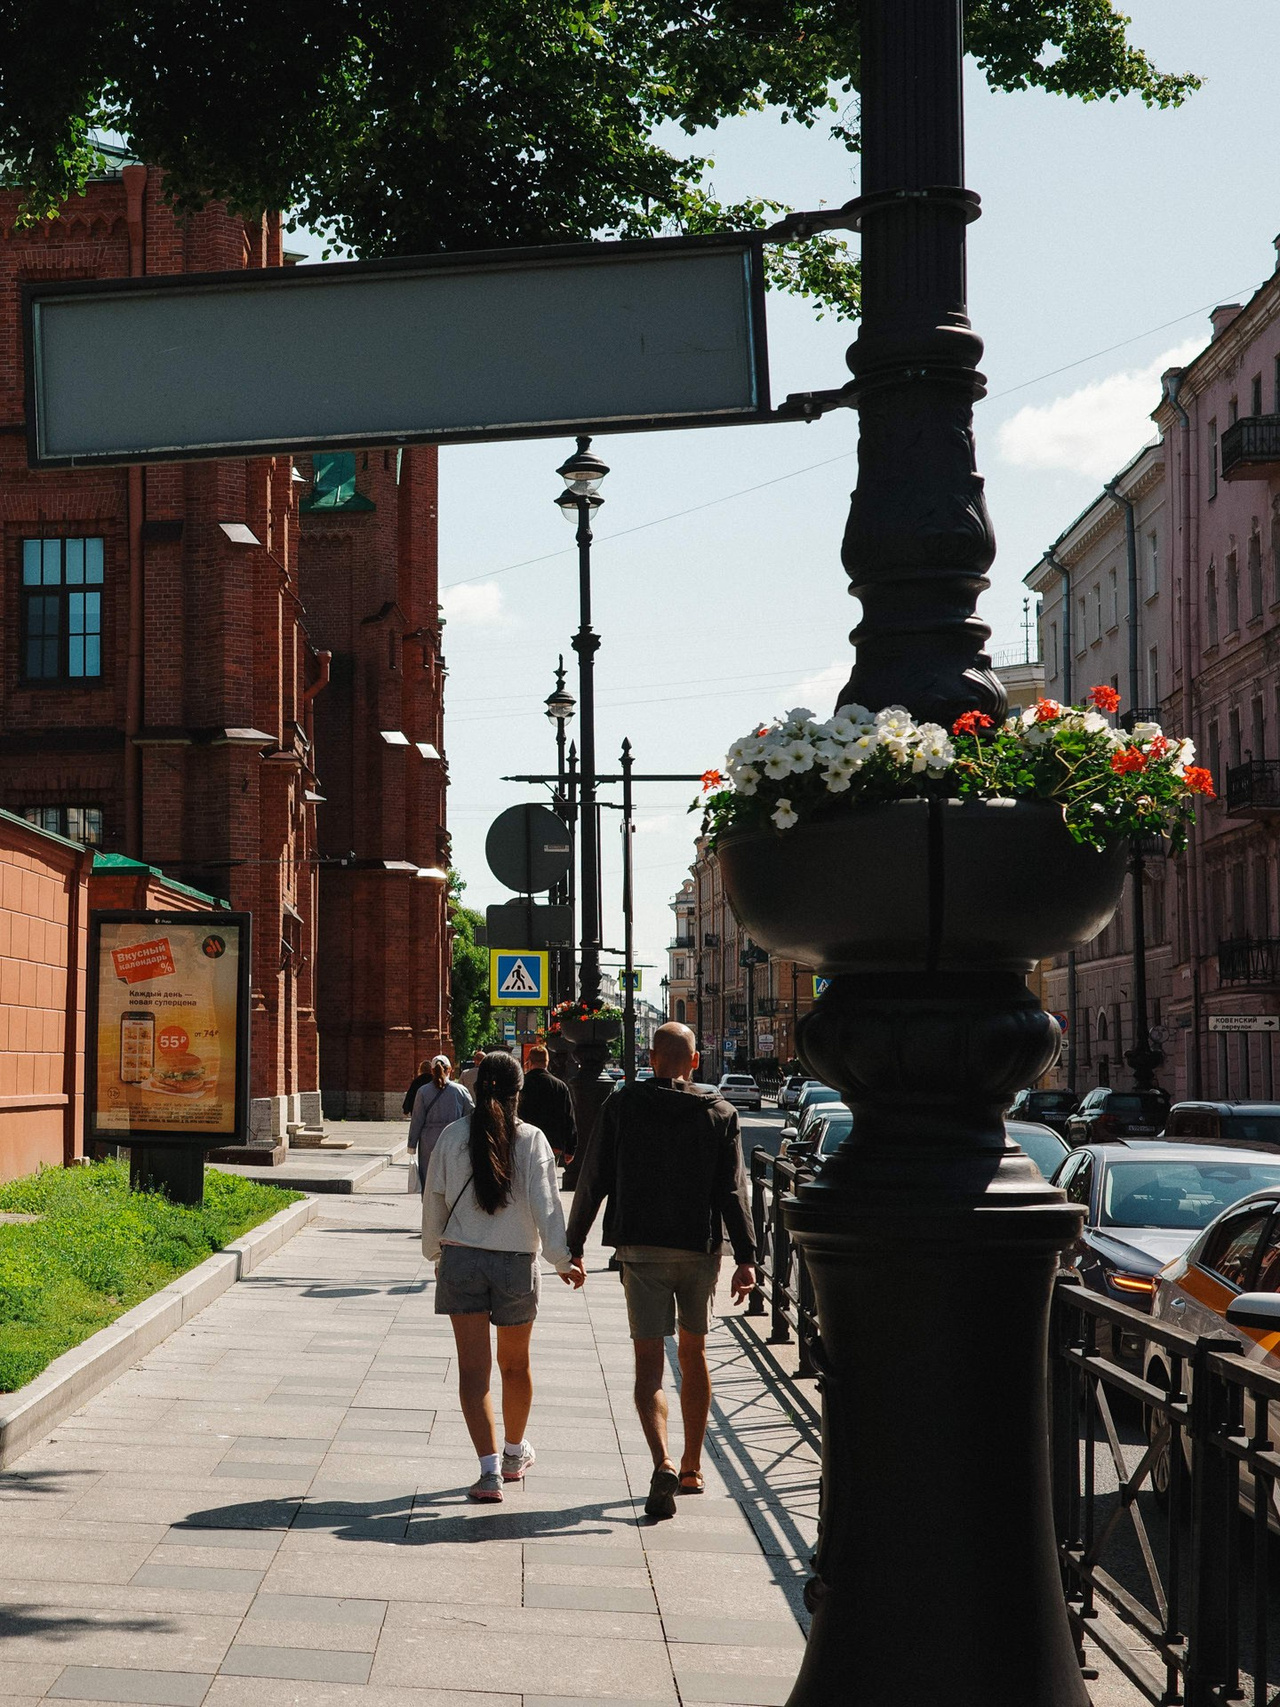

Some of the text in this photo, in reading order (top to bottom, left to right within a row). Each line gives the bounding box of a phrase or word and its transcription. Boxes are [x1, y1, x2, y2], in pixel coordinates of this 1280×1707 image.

[117, 942, 166, 963] Вкусный
[119, 954, 168, 971] календарь
[160, 961, 172, 974] %
[129, 990, 161, 998] Каждый
